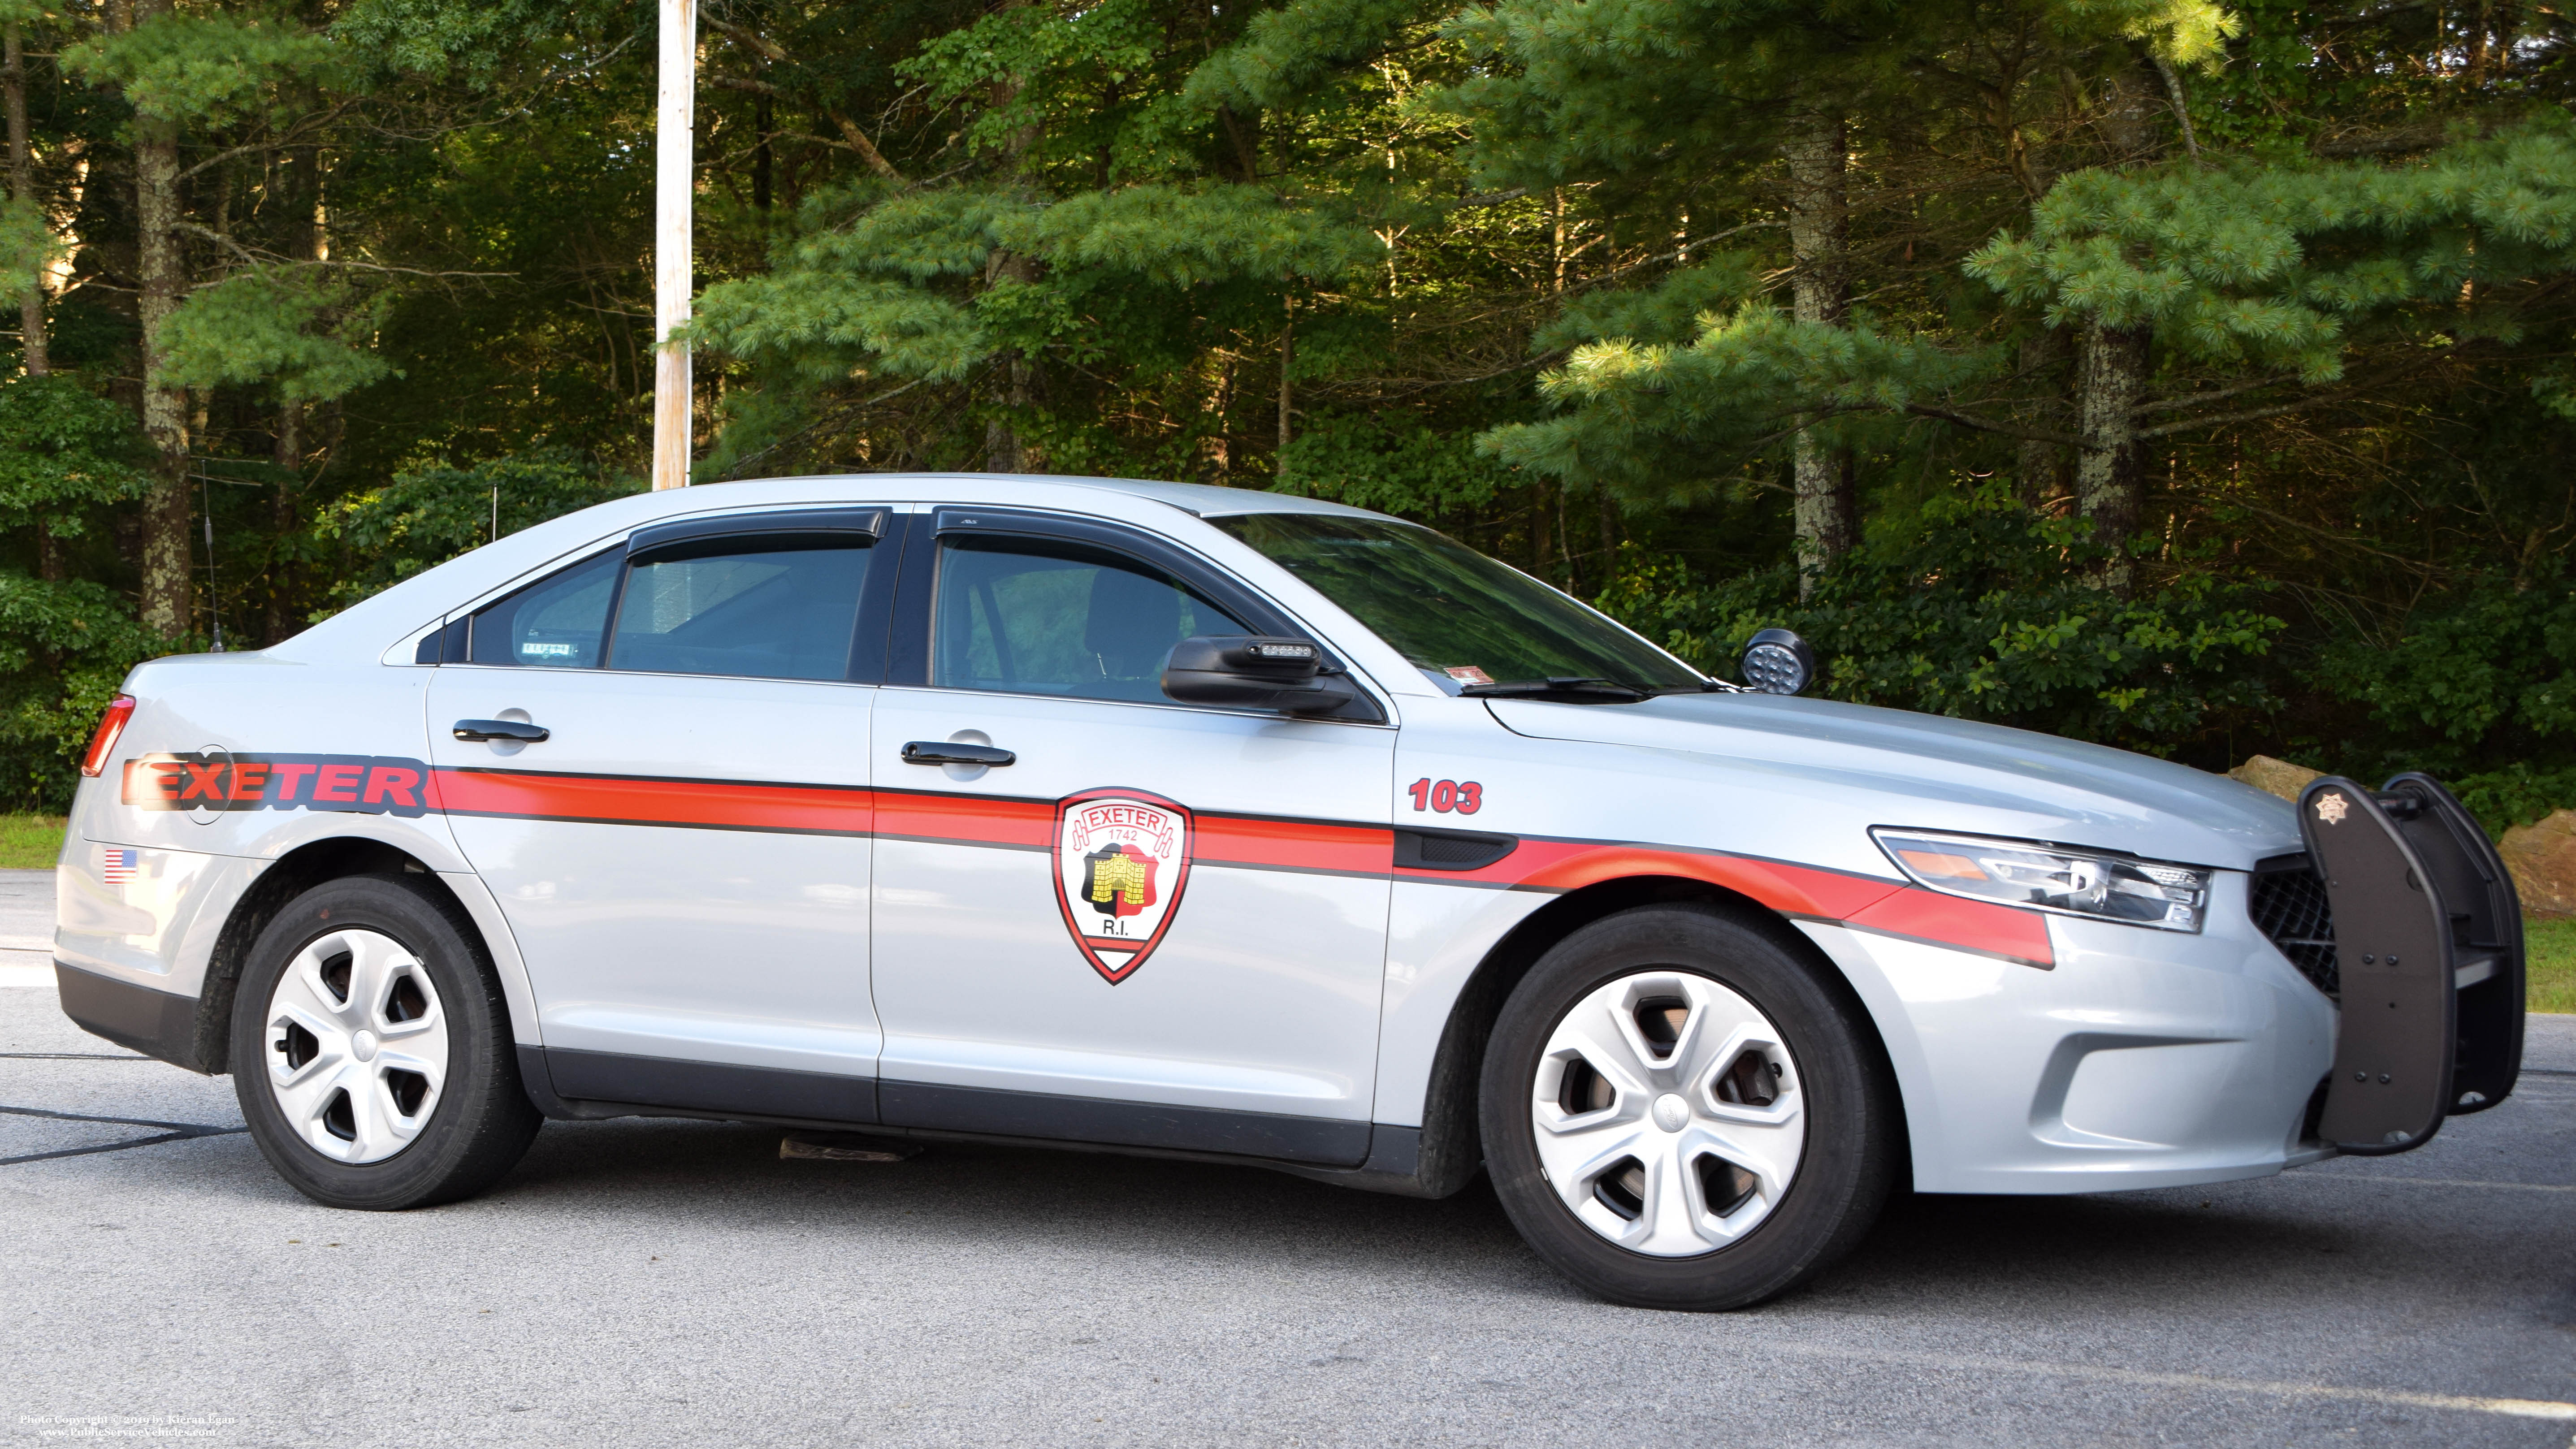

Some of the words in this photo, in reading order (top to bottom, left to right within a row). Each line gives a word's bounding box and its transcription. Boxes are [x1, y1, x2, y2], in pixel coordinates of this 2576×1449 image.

[140, 763, 419, 807] EXETER
[1408, 778, 1482, 815] 103
[1088, 808, 1160, 830] EXETER
[1109, 829, 1137, 841] 1742
[1103, 919, 1128, 936] R.I.
